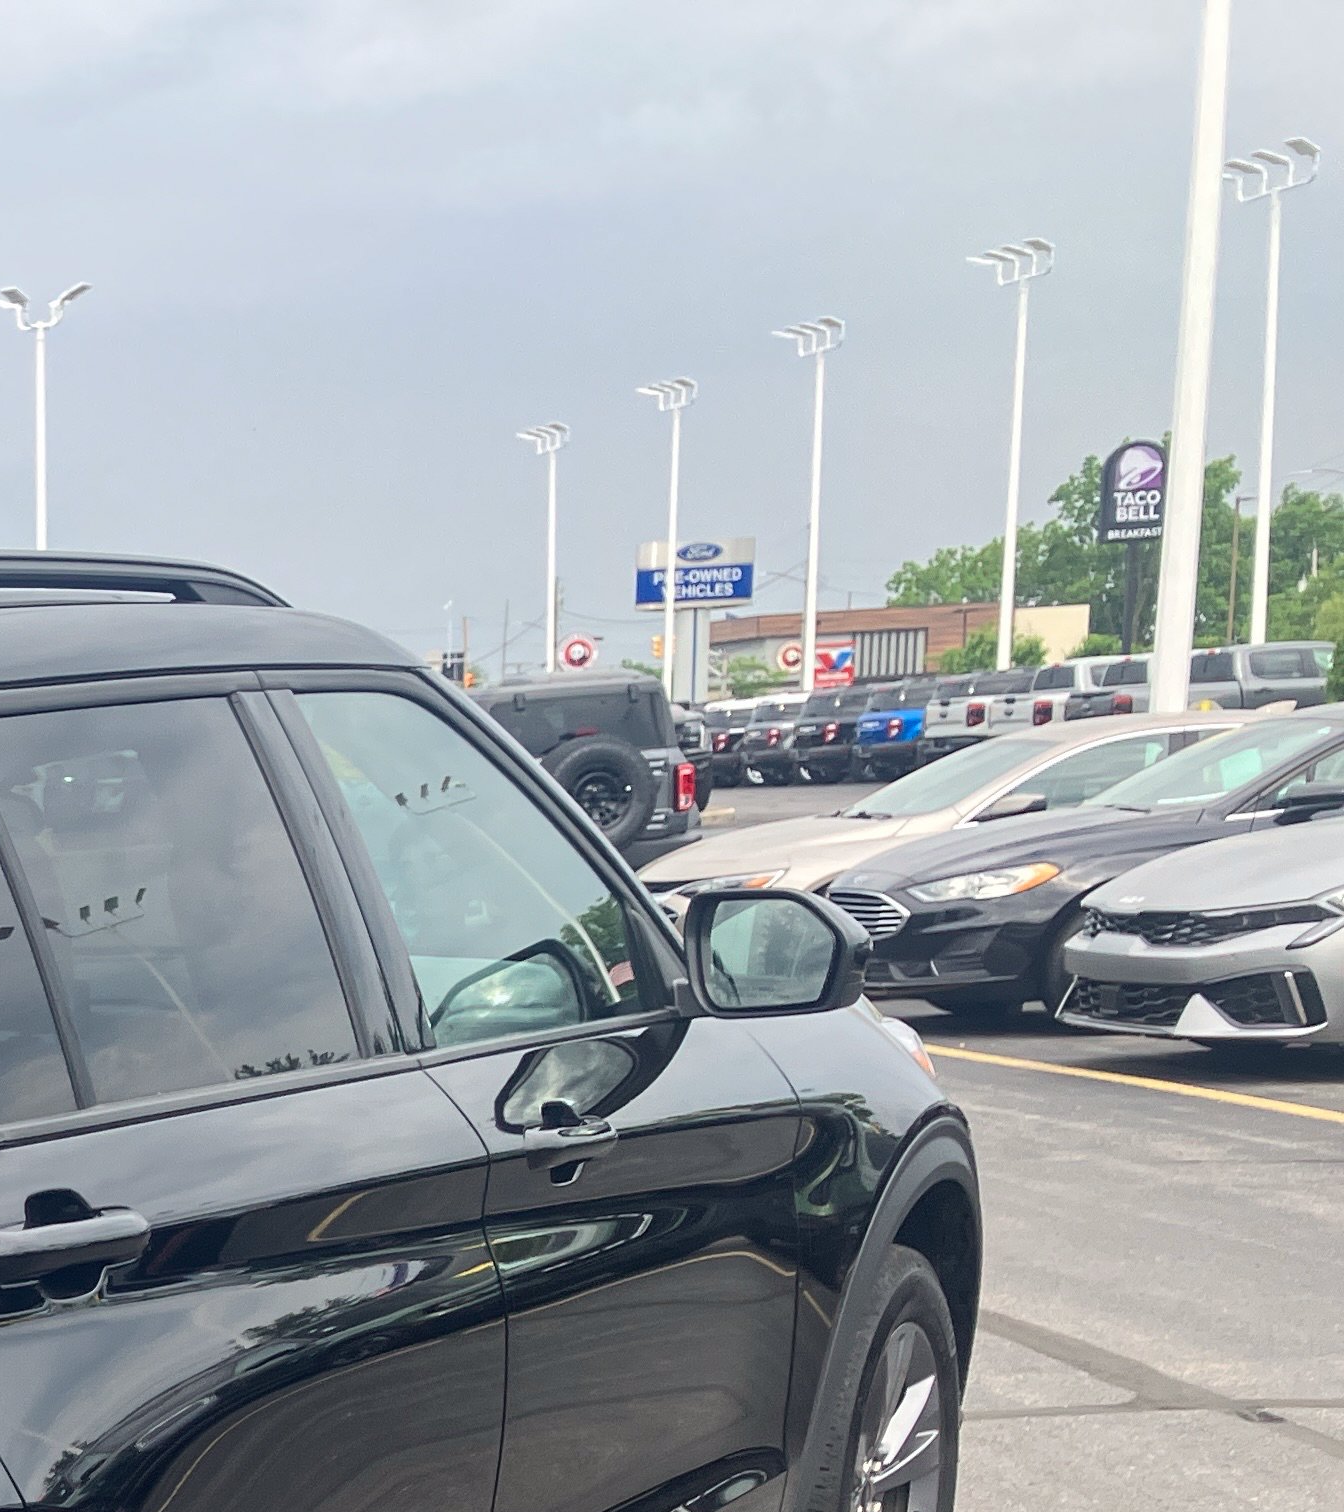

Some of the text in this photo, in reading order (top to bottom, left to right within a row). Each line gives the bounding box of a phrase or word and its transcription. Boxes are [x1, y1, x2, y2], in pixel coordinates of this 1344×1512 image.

[1113, 489, 1161, 507] TACO
[1116, 505, 1160, 523] BELL
[1107, 526, 1162, 540] BREAKFAST
[653, 566, 743, 586] PE-OWNED
